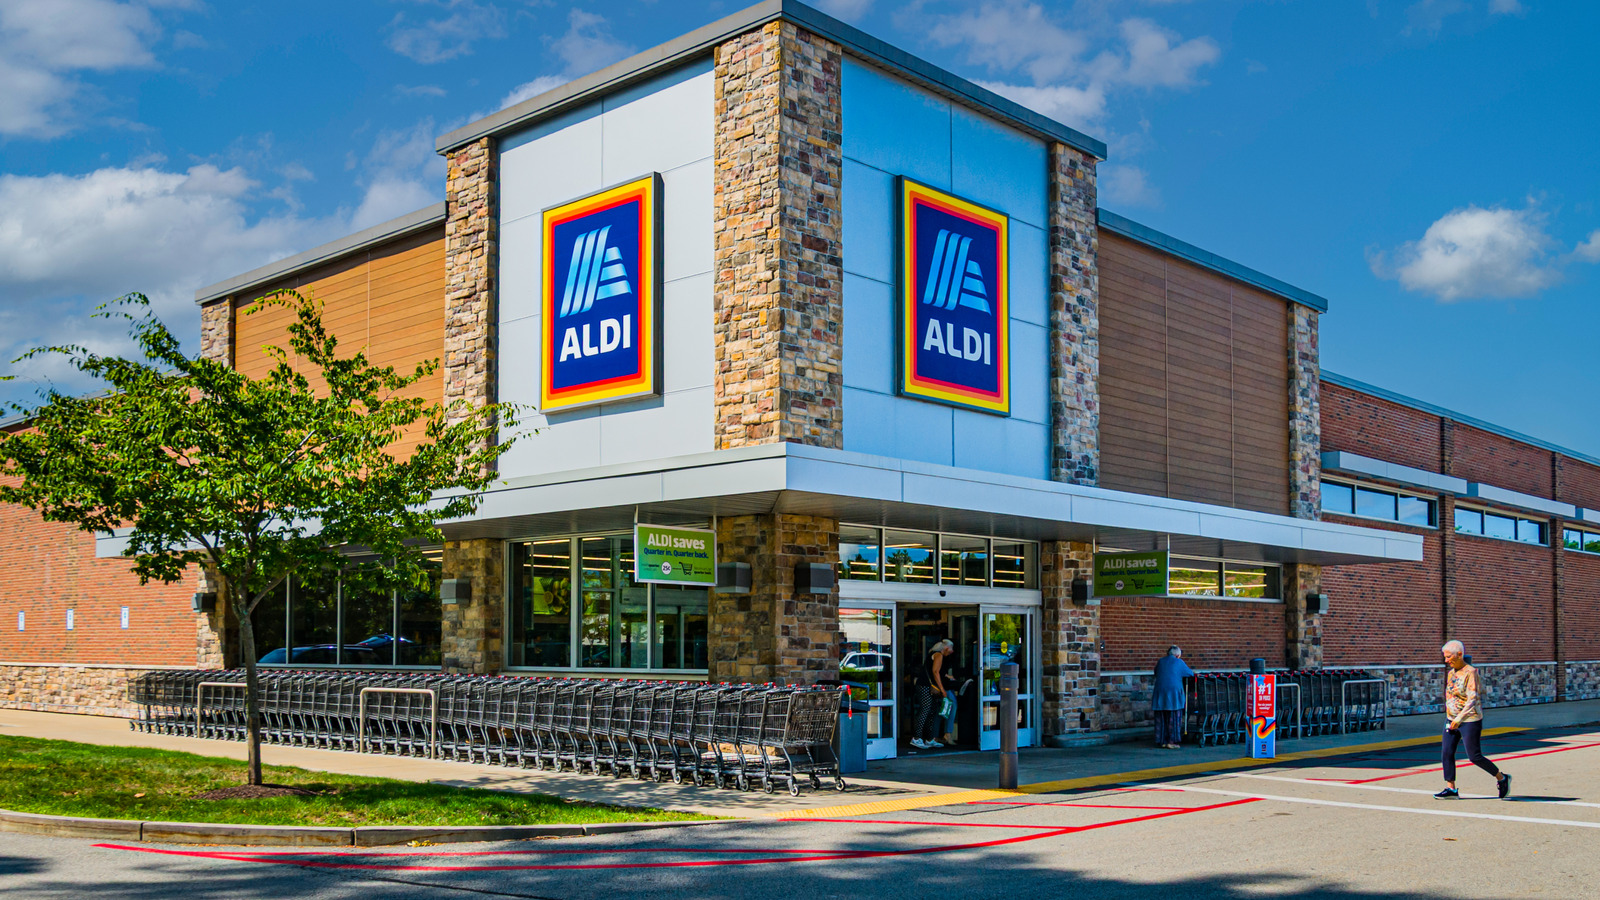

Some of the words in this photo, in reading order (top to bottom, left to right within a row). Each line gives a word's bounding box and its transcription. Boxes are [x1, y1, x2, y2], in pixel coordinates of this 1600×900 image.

[559, 313, 631, 363] ALDI
[923, 317, 991, 366] ALDI
[647, 533, 672, 547] ALDI
[673, 537, 705, 550] saves
[644, 547, 665, 556] Quarter
[673, 550, 694, 558] Quarter
[694, 551, 709, 559] back.
[1103, 558, 1126, 569] ALDI
[1126, 558, 1158, 568] saves
[1258, 683, 1271, 694] #1
